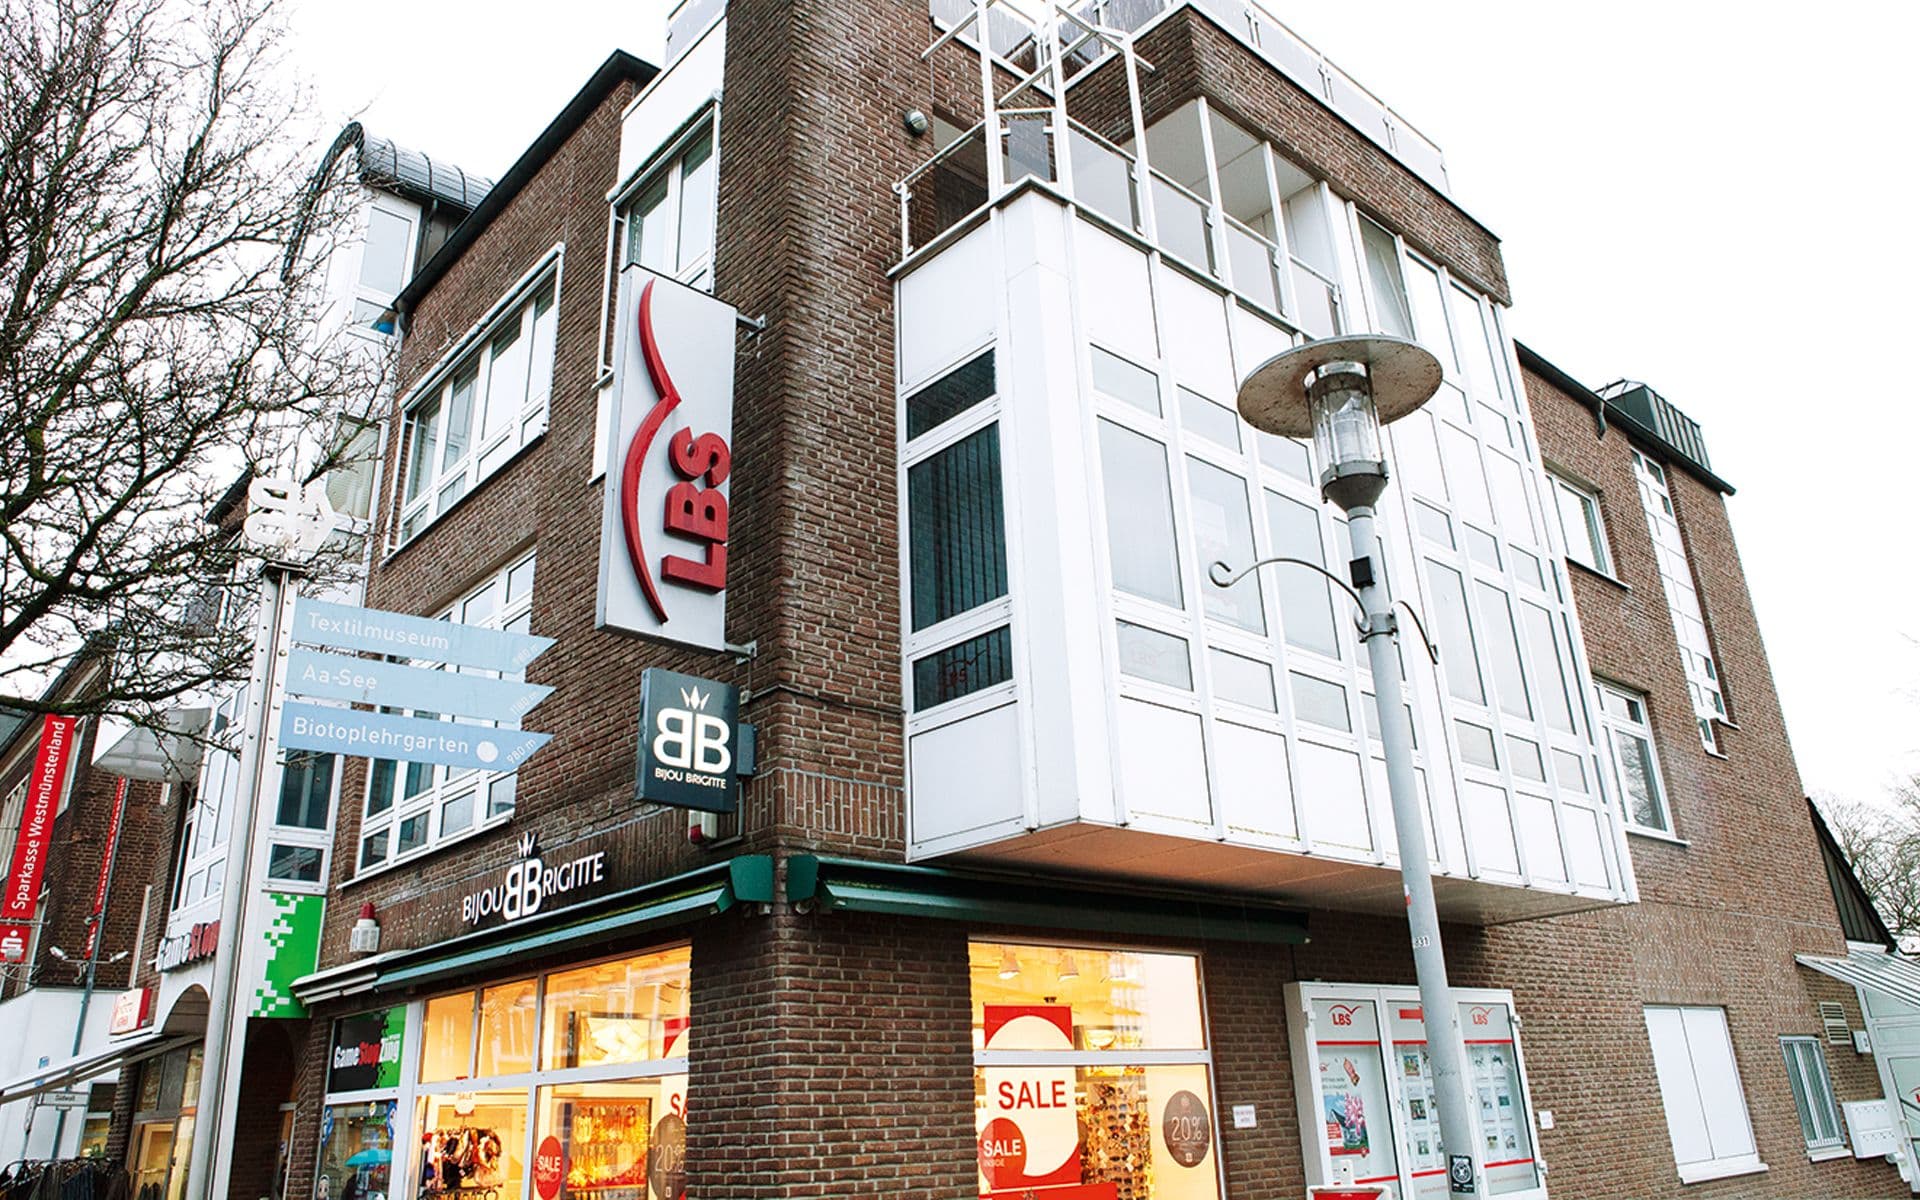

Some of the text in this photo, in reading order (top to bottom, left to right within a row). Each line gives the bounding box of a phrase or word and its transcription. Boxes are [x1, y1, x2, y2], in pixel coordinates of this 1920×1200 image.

[661, 426, 732, 595] LBS
[308, 612, 449, 650] Textilmuseum
[302, 663, 377, 690] Aa-See
[293, 716, 469, 754] Biotoplehrgarten
[506, 738, 537, 765] 980 m
[655, 767, 727, 790] BIJOU BRIGITTE
[11, 720, 66, 911] Sparkasse Westmünsterland
[462, 884, 504, 926] BIJOU
[1332, 1012, 1352, 1026] LBS
[1472, 1014, 1488, 1025] LBS
[998, 1081, 1067, 1110] SALE
[1171, 1116, 1202, 1141] 20%
[983, 1139, 1022, 1157] SALE
[537, 1155, 561, 1173] SALE
